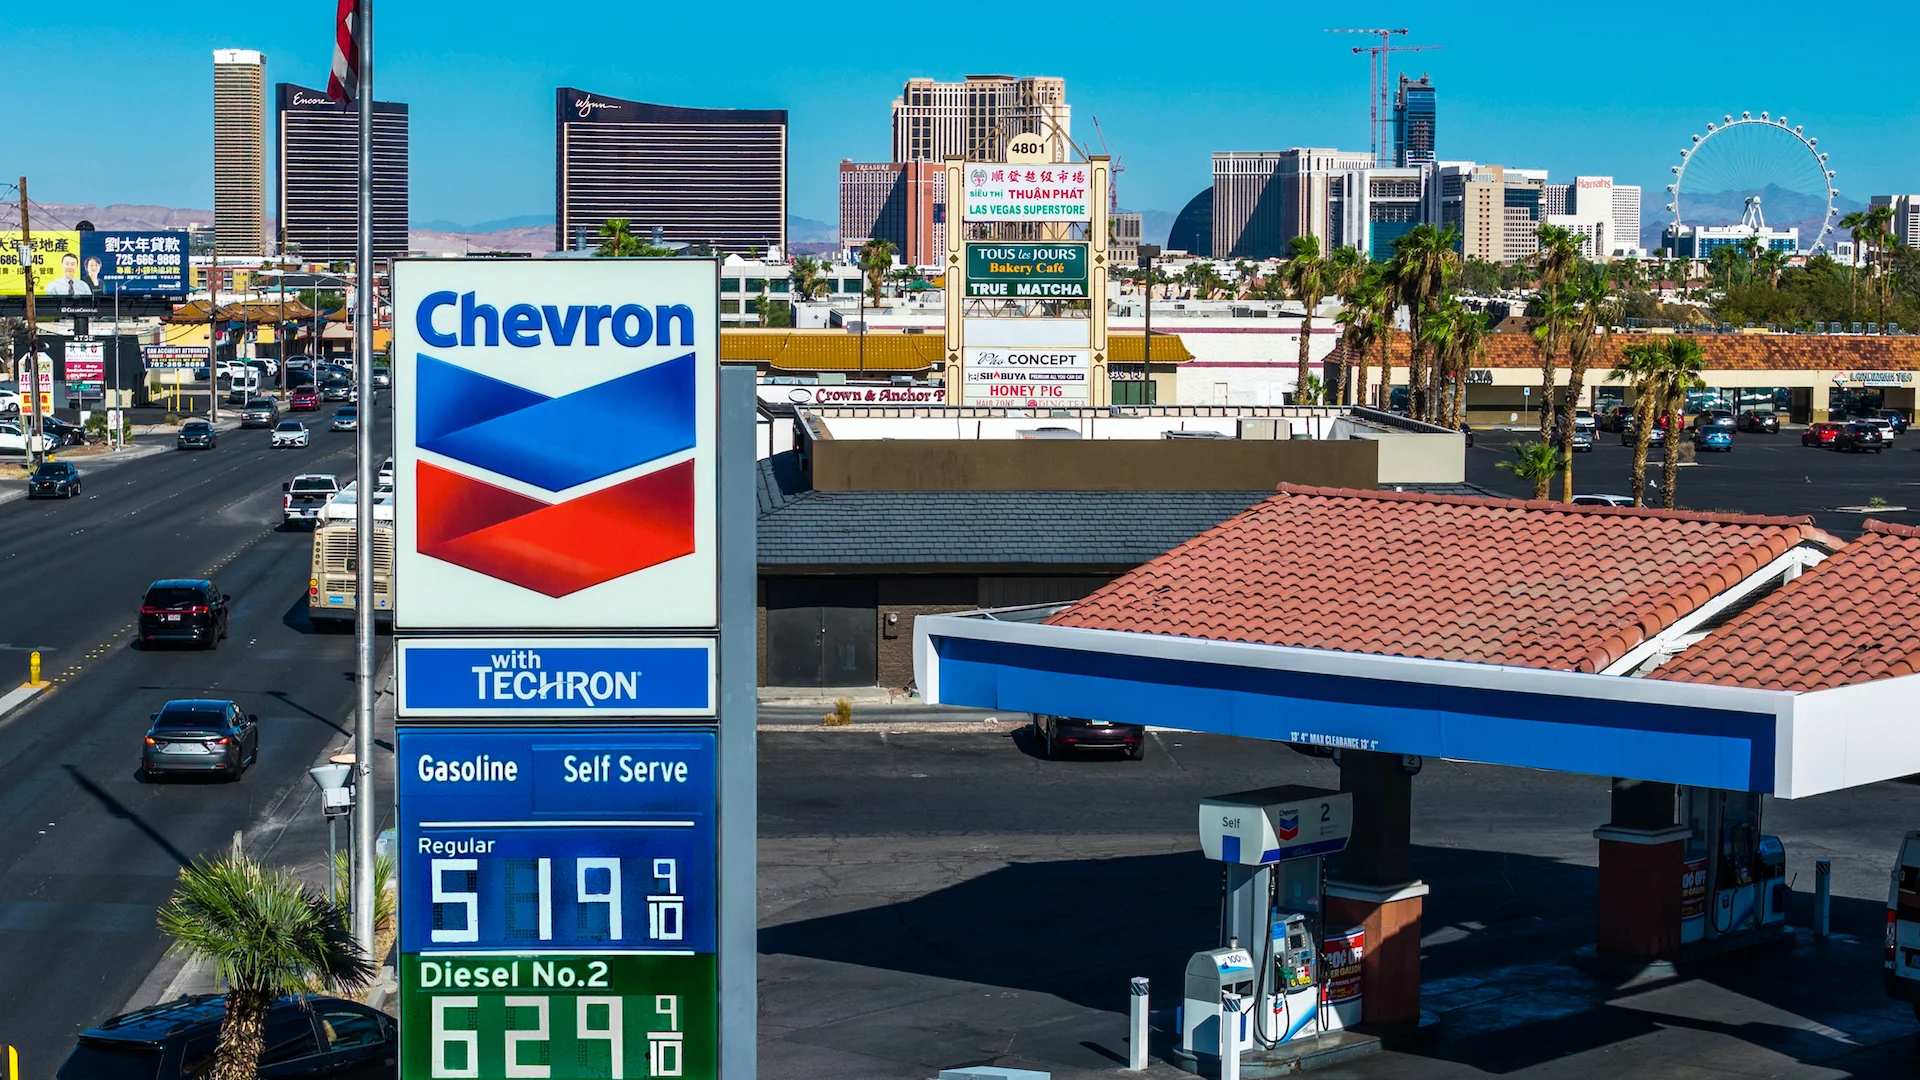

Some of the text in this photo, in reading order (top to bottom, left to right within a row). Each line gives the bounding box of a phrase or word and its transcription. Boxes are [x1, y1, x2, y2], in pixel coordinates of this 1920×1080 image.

[293, 92, 335, 105] Encore
[1012, 143, 1044, 154] 4801
[1053, 187, 1085, 199] PHÁT
[969, 205, 1085, 215] LAS VEGAS SUPERSTORE
[115, 253, 181, 266] 725-666-9888
[978, 248, 1077, 261] TOUS les JOURS
[989, 262, 1065, 275] Bakery Café
[971, 283, 1083, 295] TRUE MATCHA
[415, 290, 695, 348] Chevron
[977, 351, 1077, 365] Pho CONCEPT
[980, 370, 1026, 380] SHABUYA
[1850, 372, 1913, 382] LANDMARK TEA
[816, 388, 862, 403] Crown
[864, 390, 876, 402] &
[878, 387, 931, 402] Anchor
[990, 385, 1063, 397] HONEY PIG
[491, 650, 541, 669] with
[472, 666, 638, 706] TECHRON
[1310, 733, 1325, 744] MAX
[1325, 735, 1360, 749] CLEARANCE
[1408, 755, 1415, 765] 2
[418, 754, 688, 782] Gasoline Self Serve
[1279, 808, 1299, 817] Chevron
[1320, 803, 1330, 823] 2
[1222, 816, 1241, 829] Self
[418, 838, 496, 857] Regular
[1348, 946, 1363, 965] OFF
[420, 961, 609, 988] Diesel No.2
